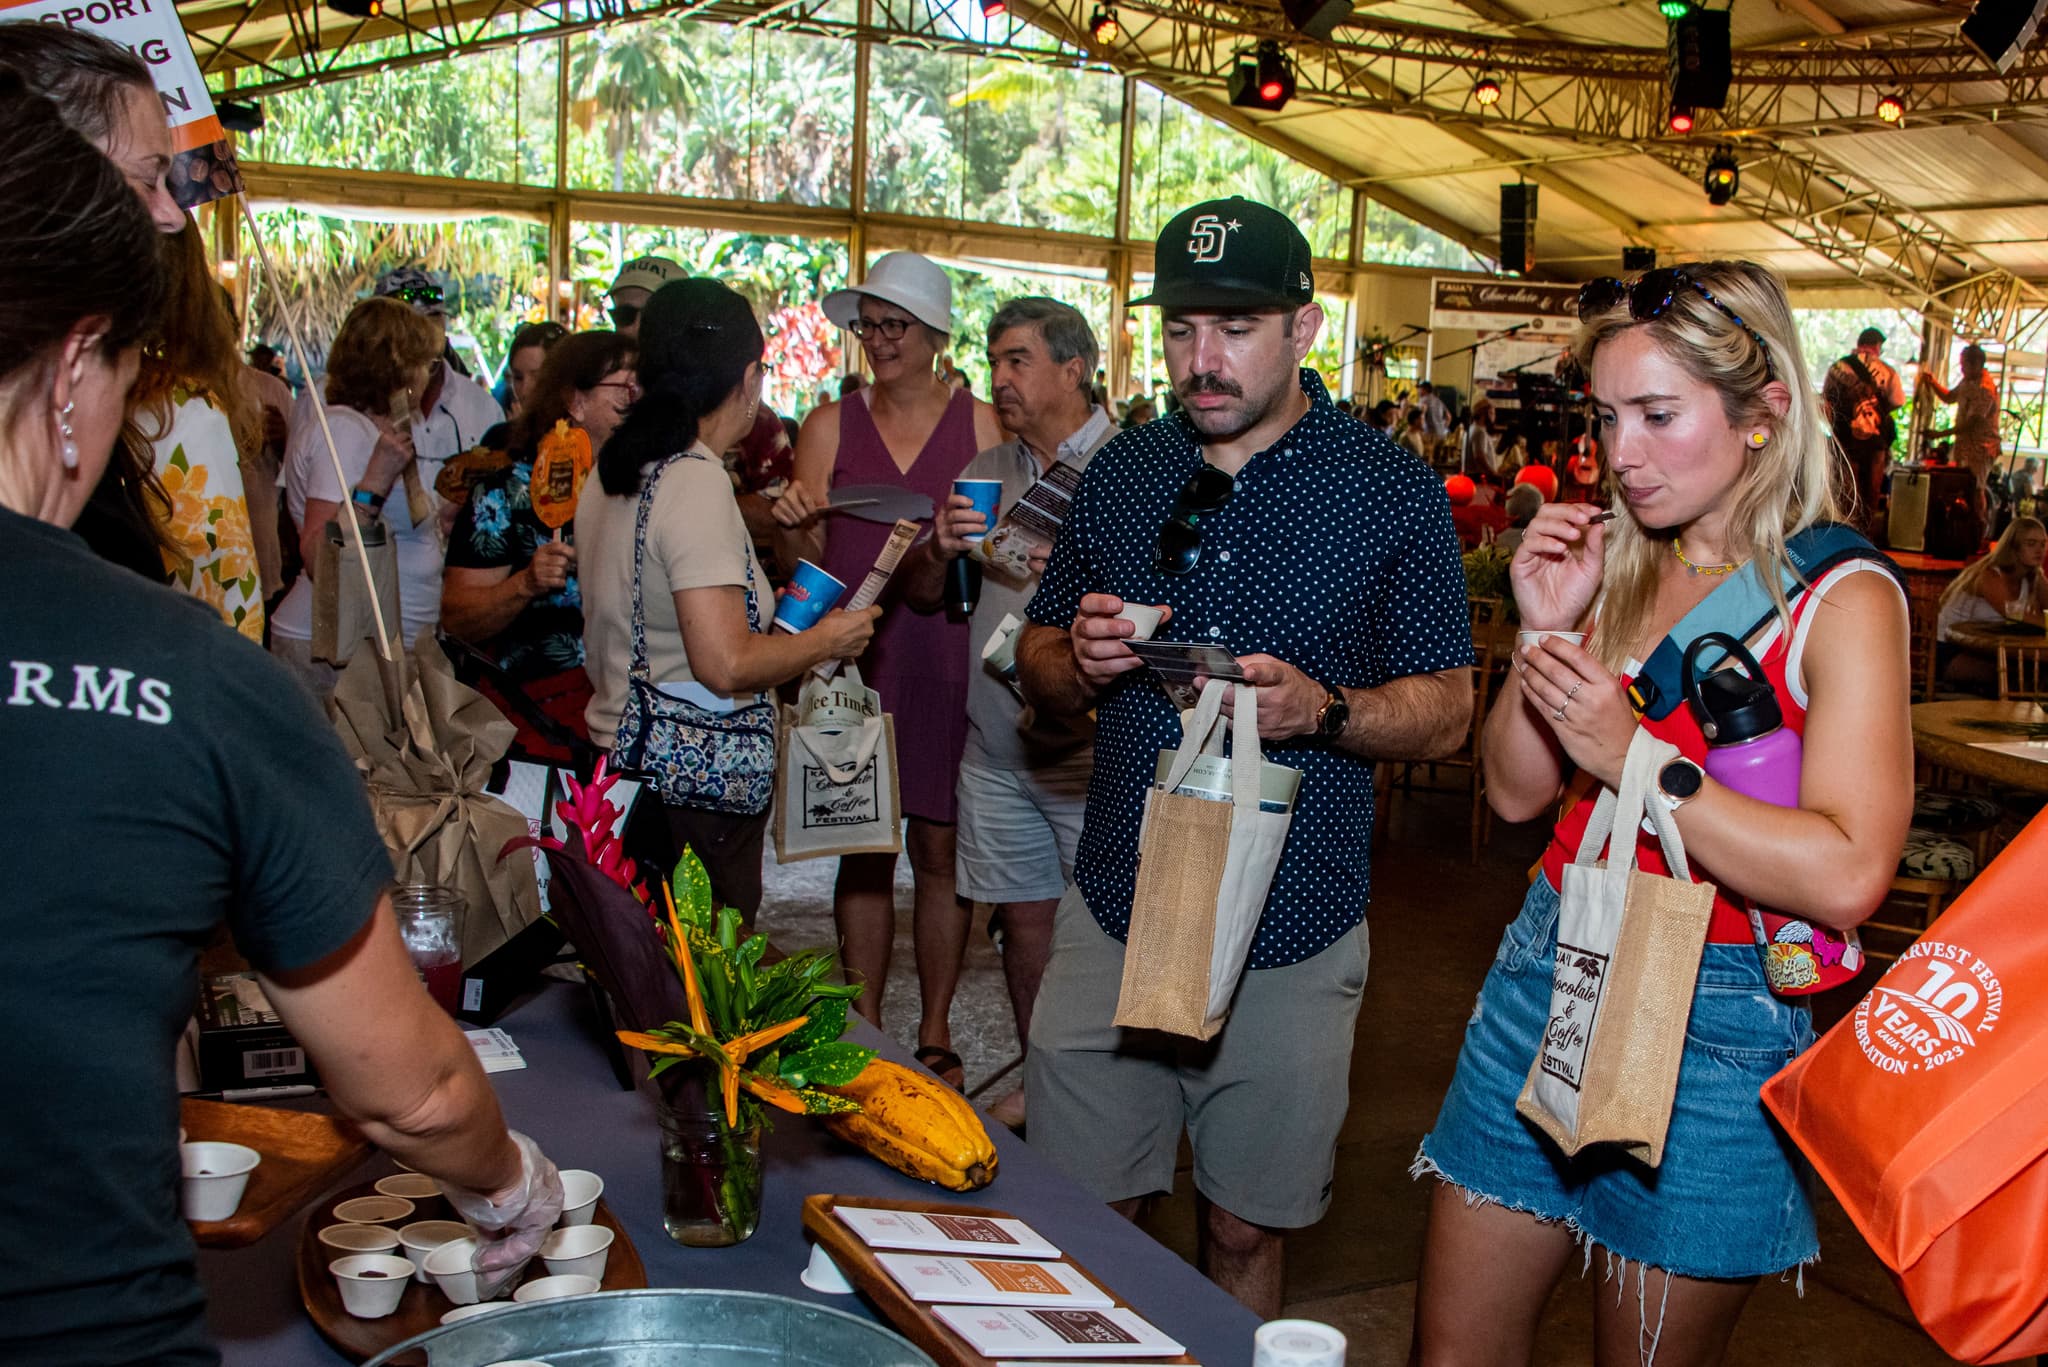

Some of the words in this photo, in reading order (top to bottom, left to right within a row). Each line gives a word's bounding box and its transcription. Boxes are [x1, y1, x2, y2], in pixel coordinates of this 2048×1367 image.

[831, 690, 875, 717] Times
[815, 814, 871, 824] FESTIVAL
[1915, 959, 1979, 1020] 10
[1968, 957, 2003, 1033] FESTIVAL
[1562, 1000, 1577, 1020] &
[1874, 993, 1941, 1056] YEARS
[1549, 1015, 1584, 1051] Coffee
[1924, 1045, 1965, 1071] 2023
